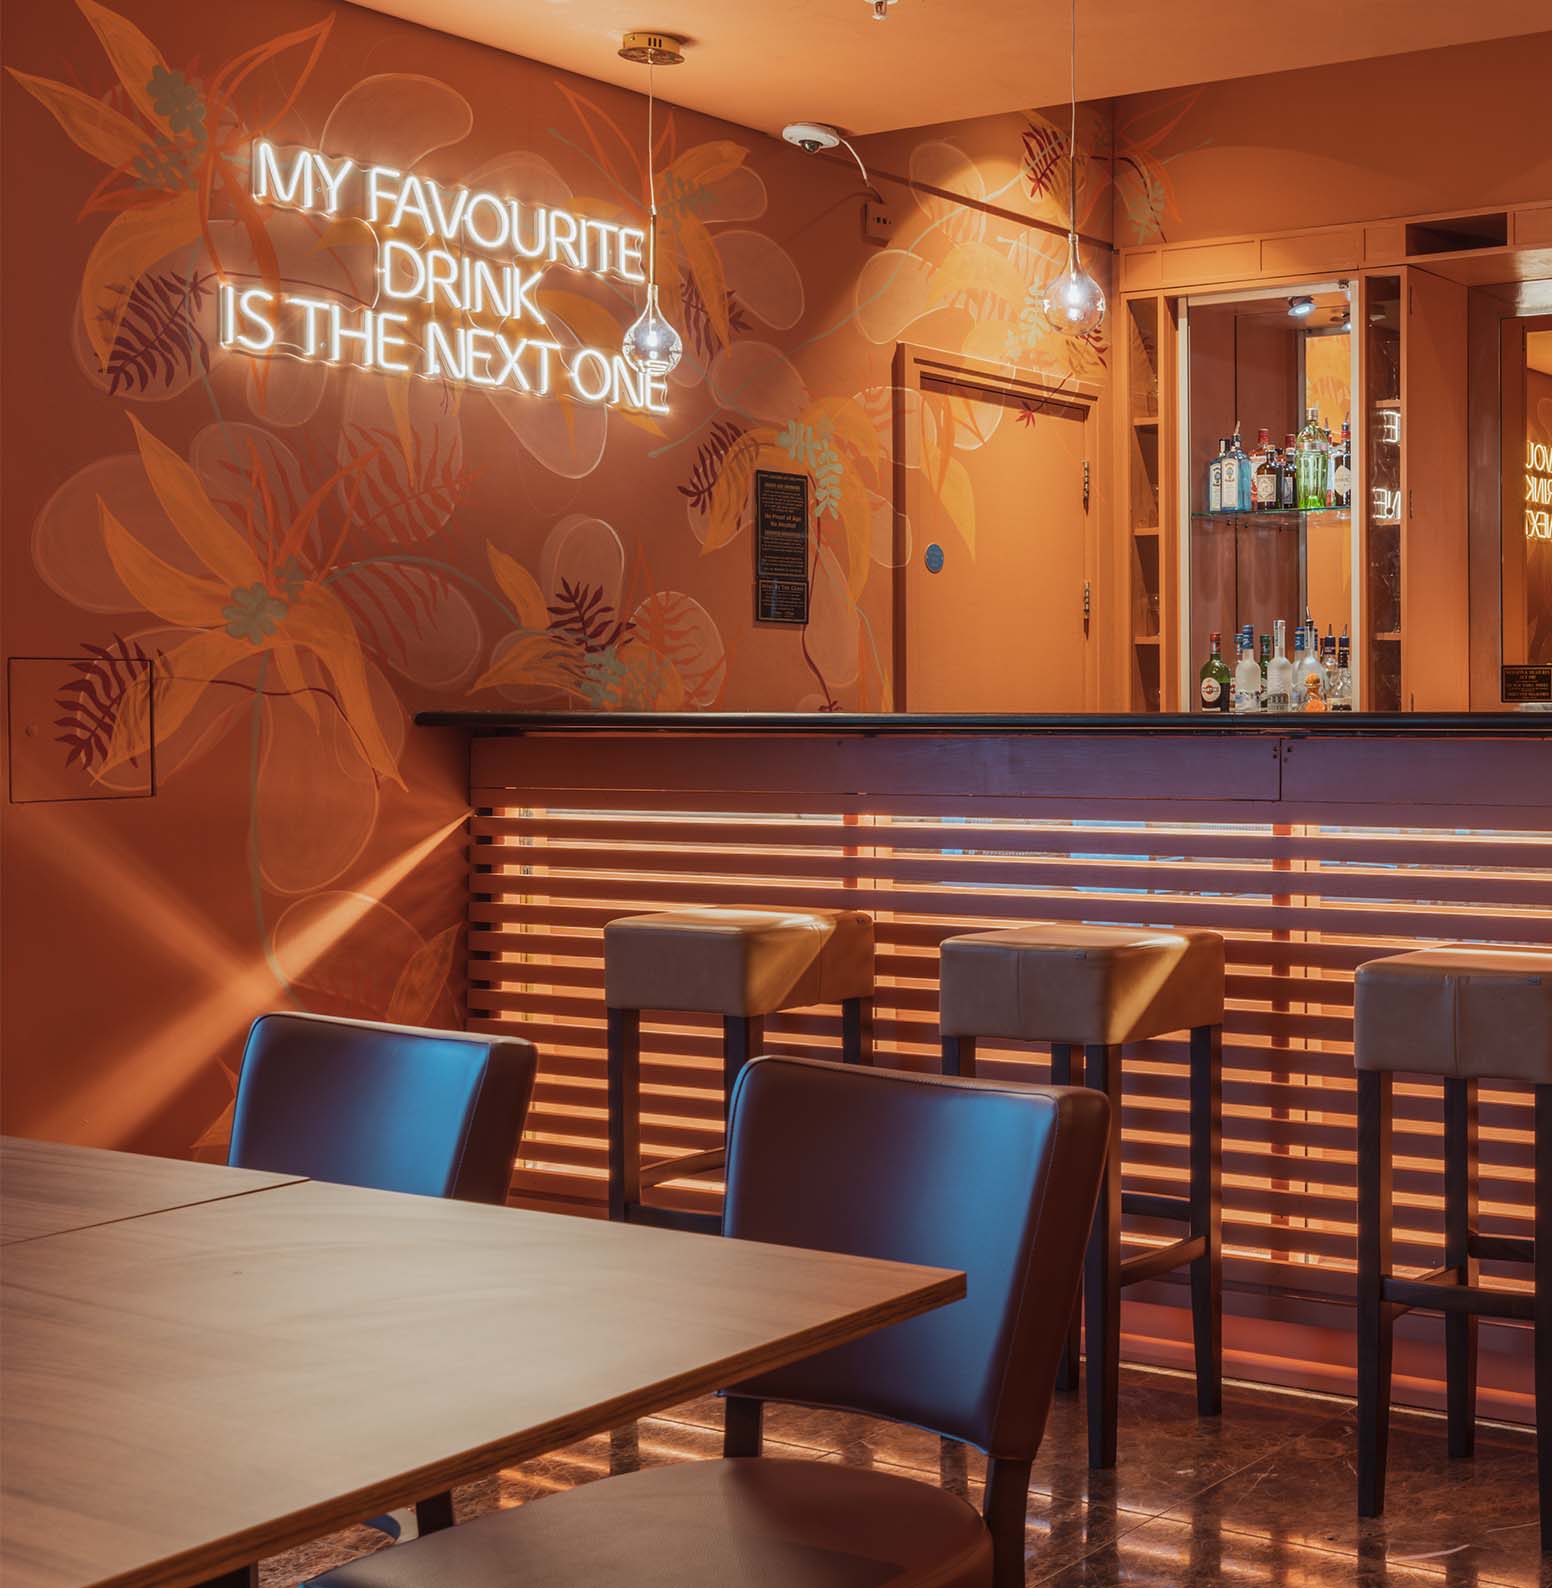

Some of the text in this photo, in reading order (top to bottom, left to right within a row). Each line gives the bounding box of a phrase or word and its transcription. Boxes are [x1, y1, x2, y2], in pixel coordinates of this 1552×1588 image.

[257, 140, 647, 282] MY FAVOURITE
[382, 240, 546, 324] DRINK
[221, 285, 670, 415] IS THE NEXT ONE
